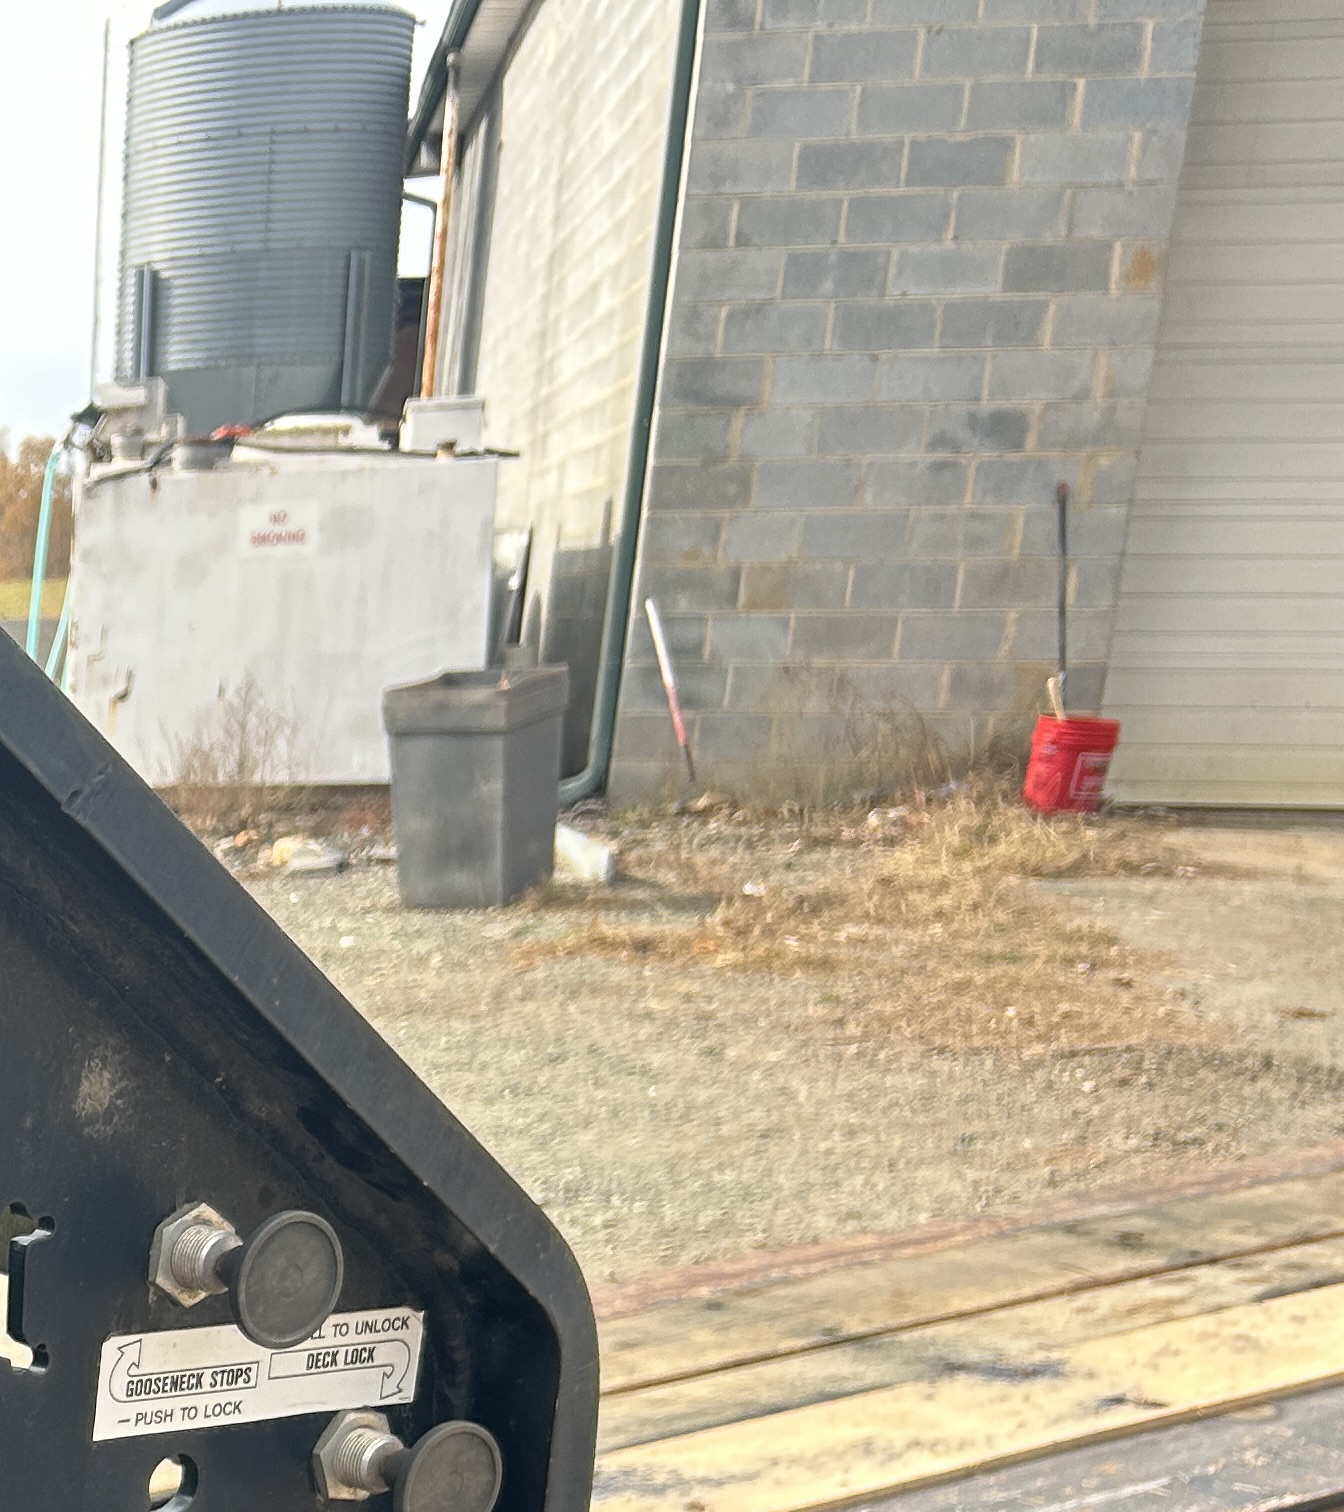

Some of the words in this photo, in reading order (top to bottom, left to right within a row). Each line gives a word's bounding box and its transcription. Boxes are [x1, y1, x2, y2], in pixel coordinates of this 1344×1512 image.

[332, 1323, 349, 1338] TO
[354, 1315, 411, 1335] UNLOCK
[305, 1349, 340, 1371] DECK
[343, 1345, 377, 1366] LOCK
[125, 1372, 205, 1398] GOOSENECK
[209, 1367, 252, 1389] STOPS
[134, 1404, 173, 1427] PUSH
[179, 1405, 198, 1422] TO
[203, 1400, 244, 1418] LOCK
